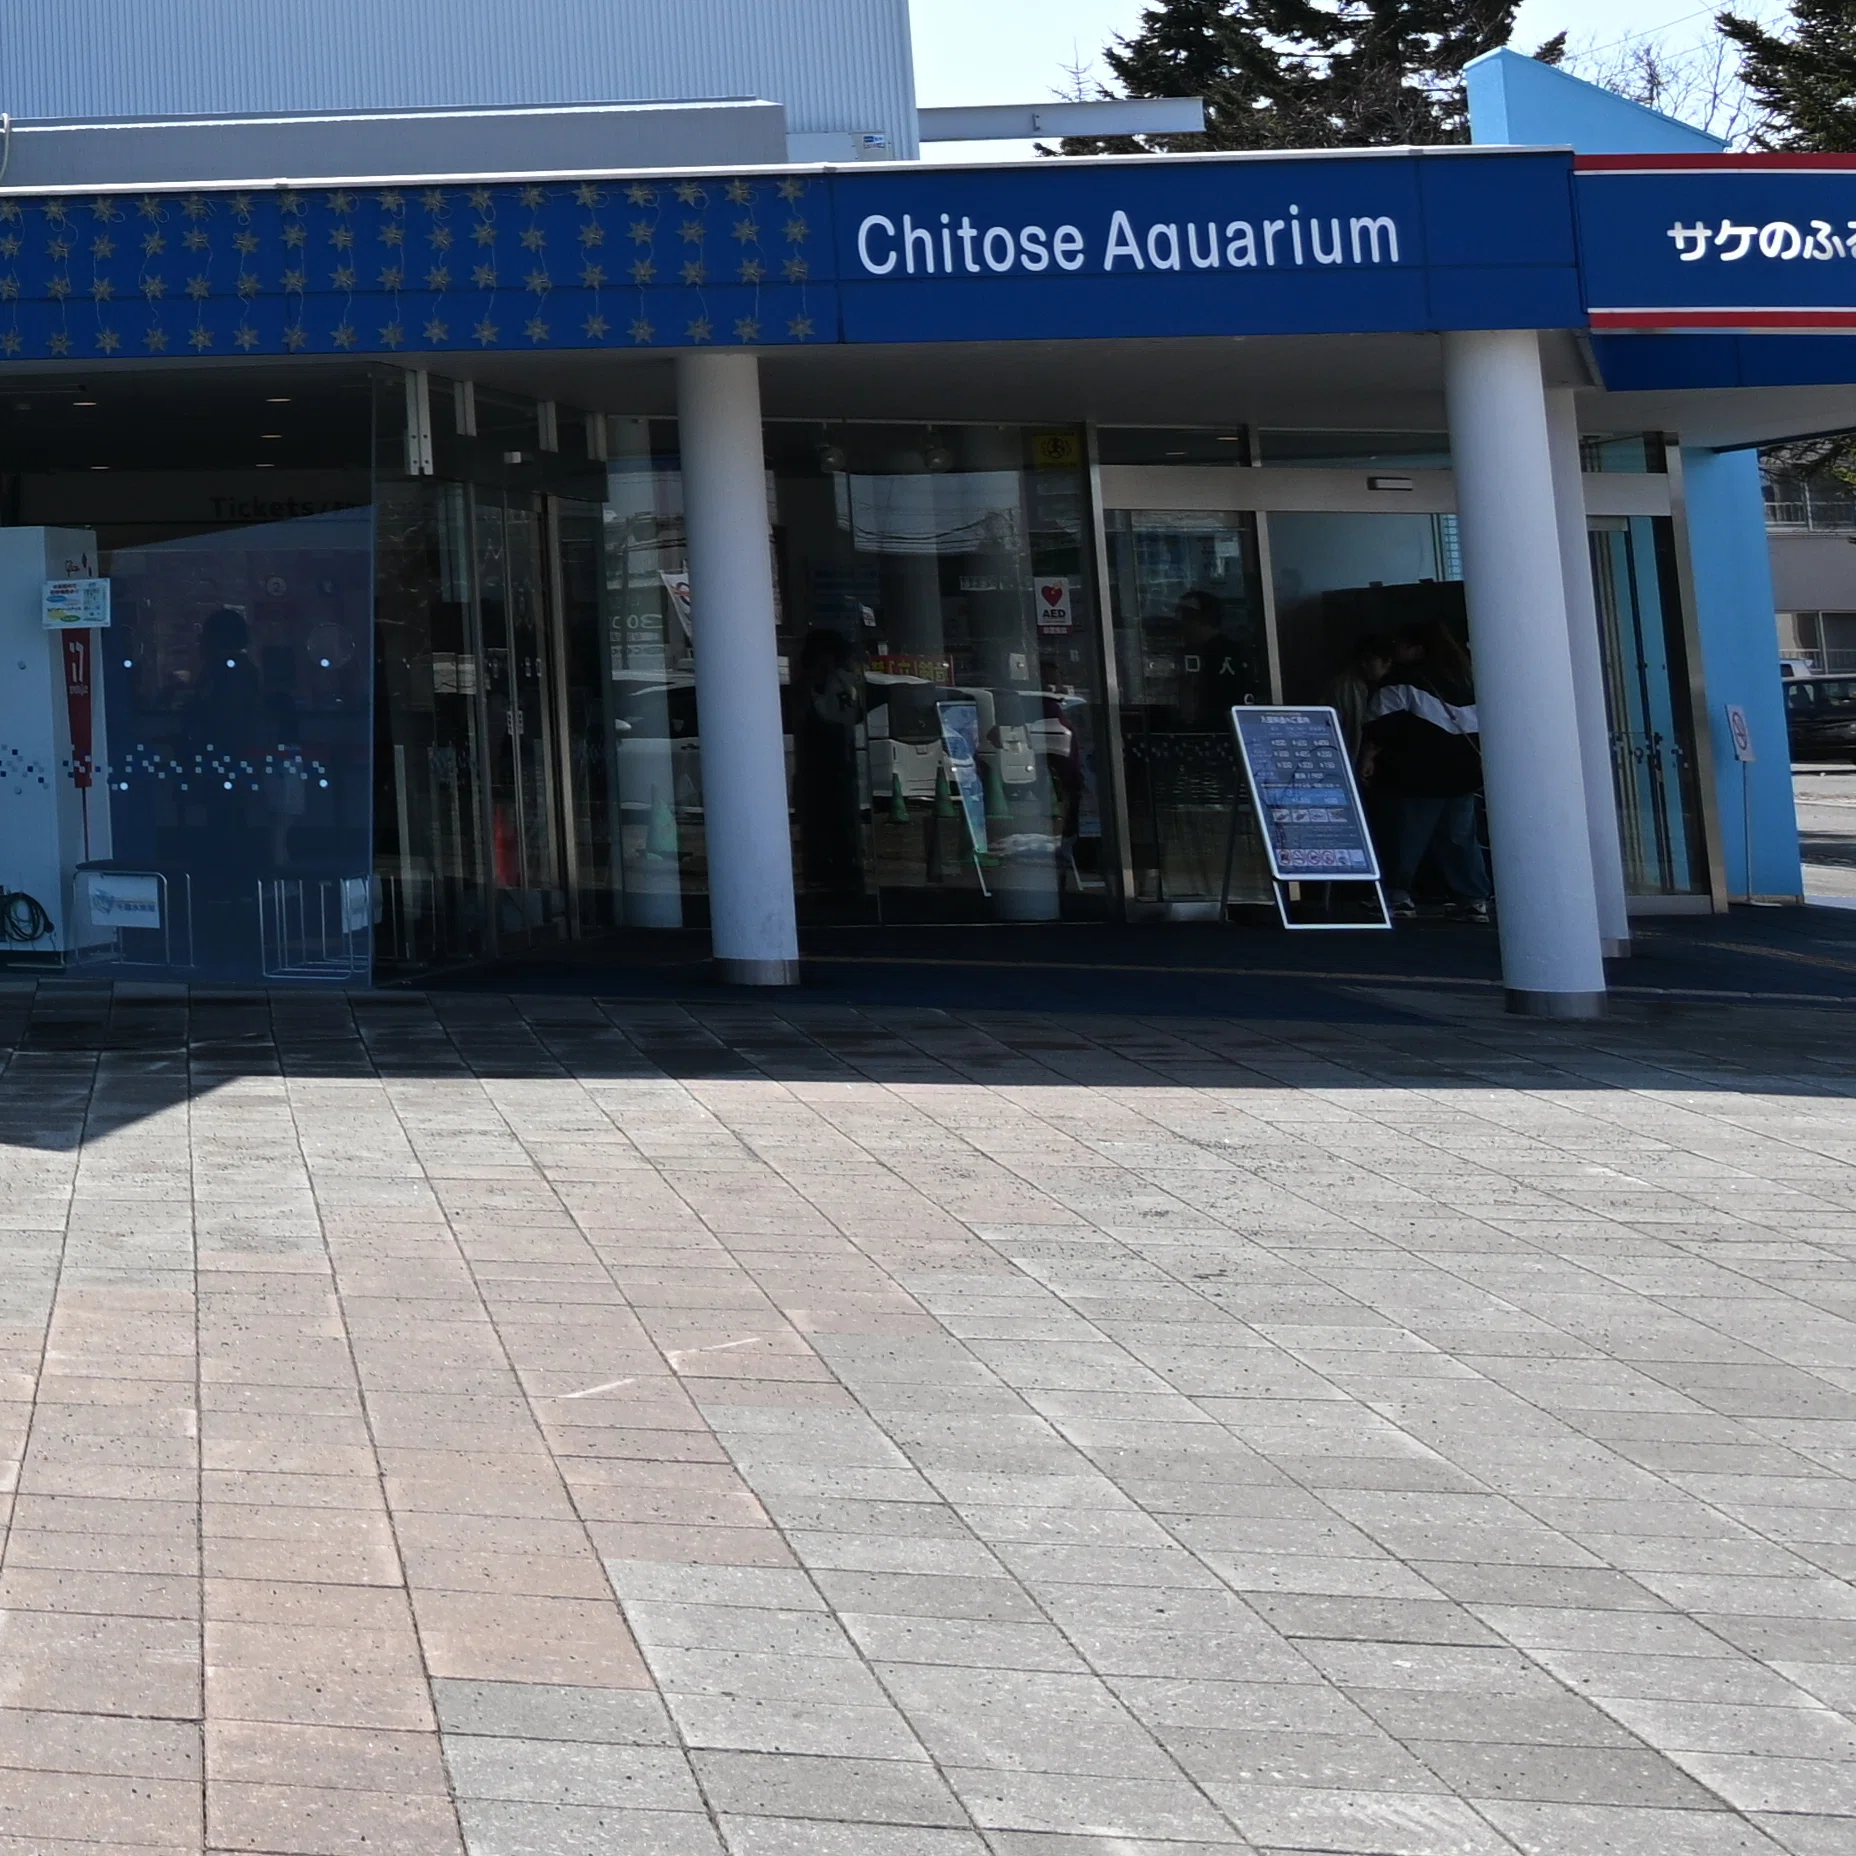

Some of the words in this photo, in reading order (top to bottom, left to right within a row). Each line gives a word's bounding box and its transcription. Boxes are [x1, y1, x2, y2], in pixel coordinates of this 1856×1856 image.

[857, 213, 1085, 275] Chitose
[1104, 204, 1400, 272] Aquarium
[1042, 609, 1066, 618] AED
